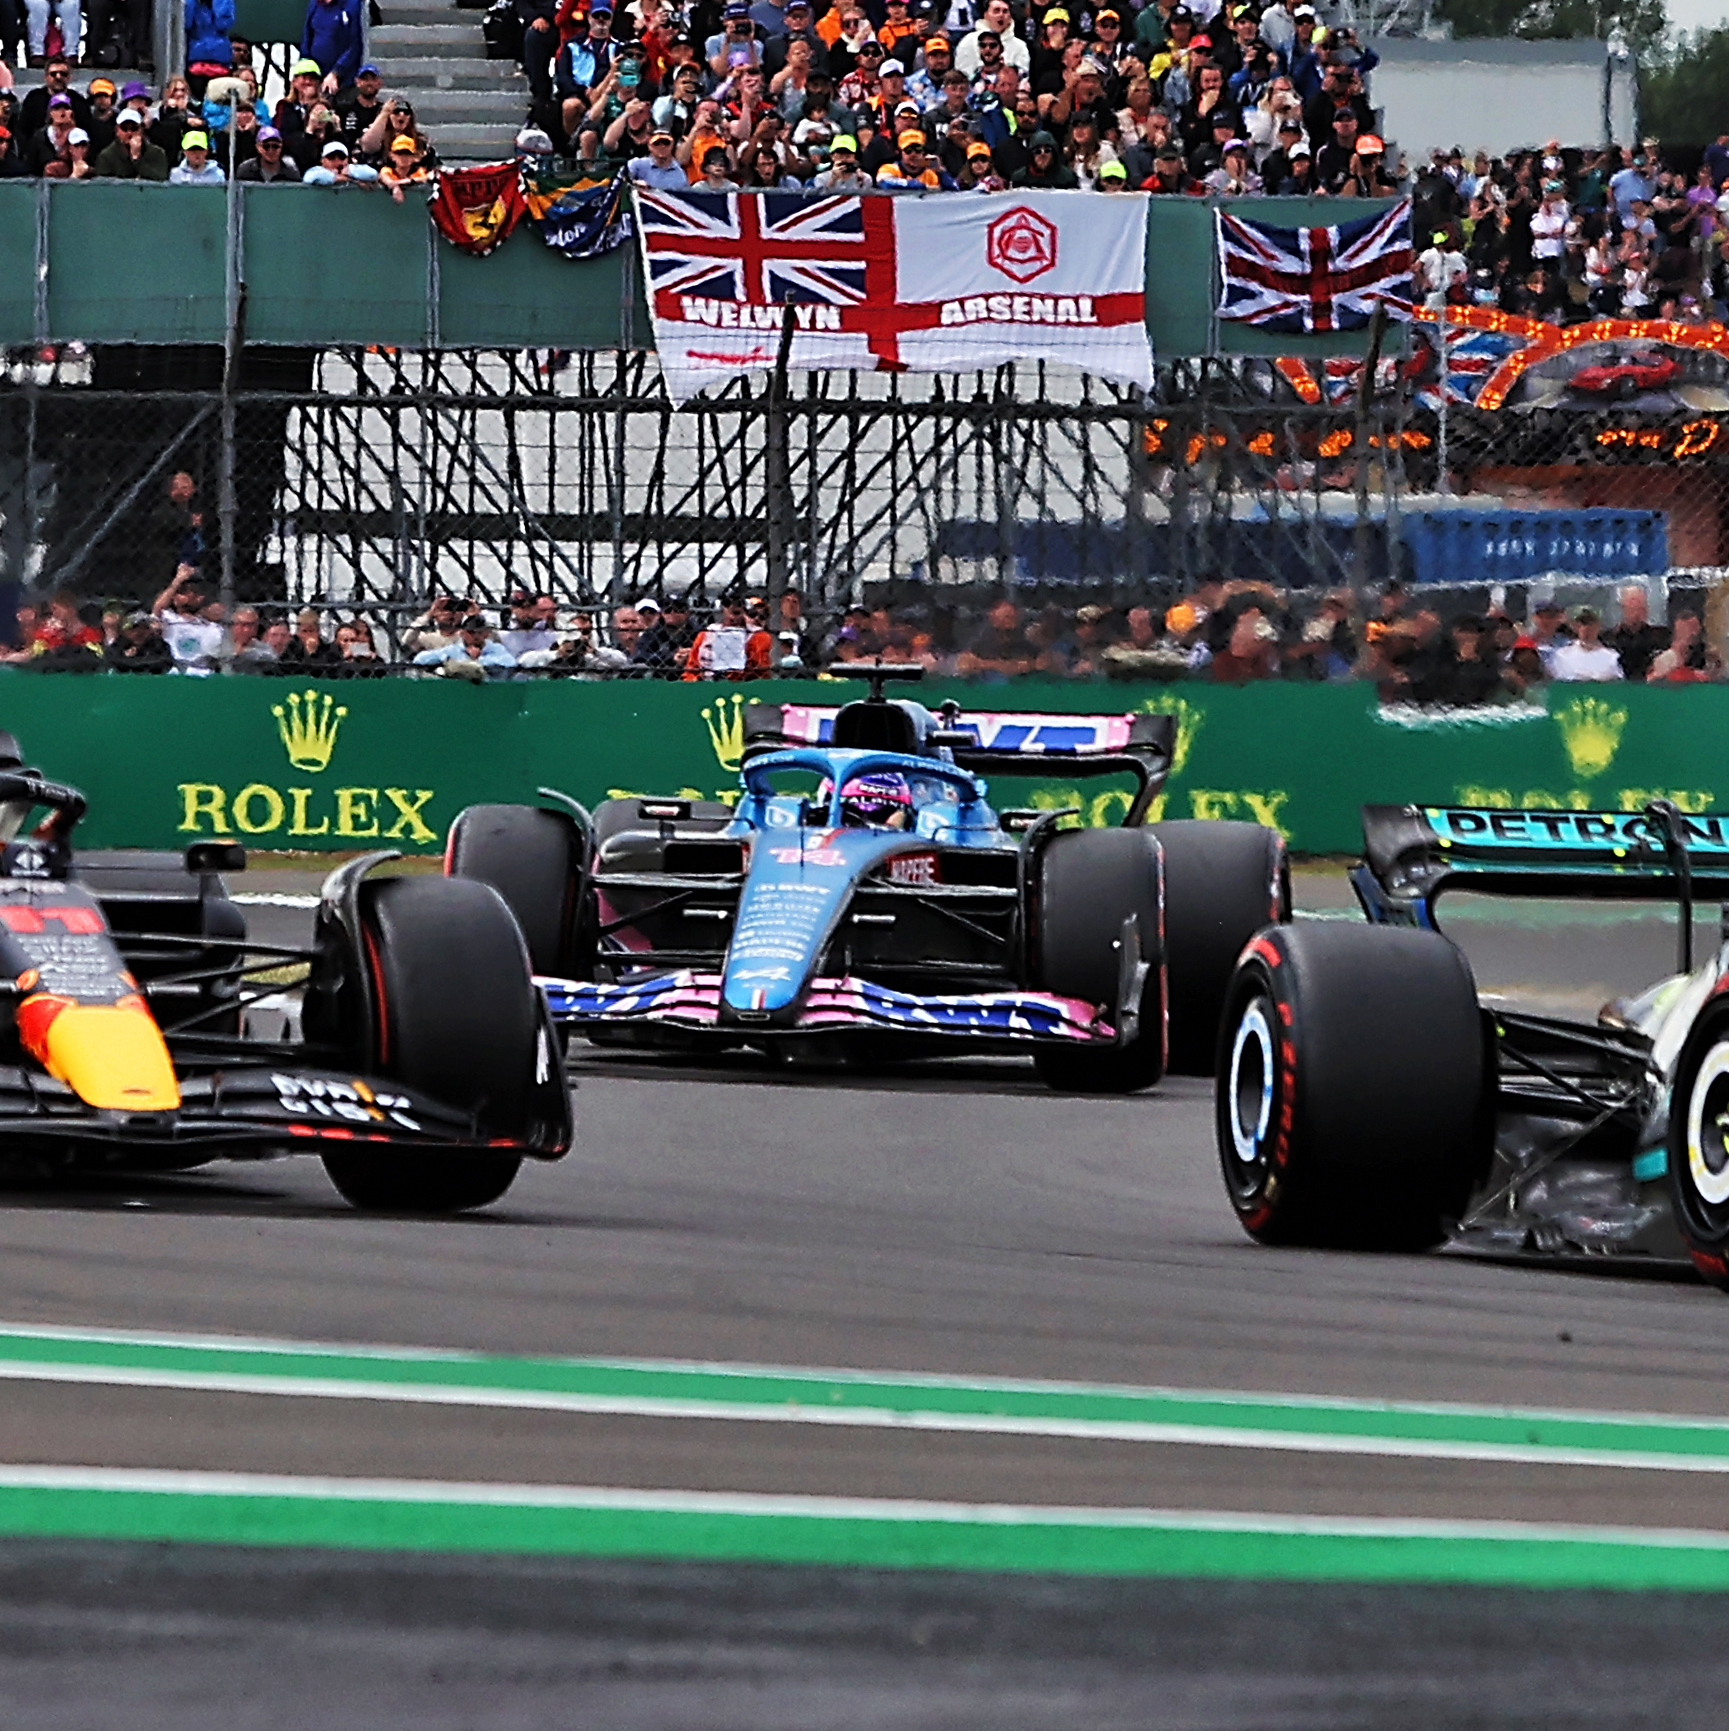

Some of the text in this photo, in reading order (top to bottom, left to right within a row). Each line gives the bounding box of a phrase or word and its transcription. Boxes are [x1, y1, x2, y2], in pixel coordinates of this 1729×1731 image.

[681, 296, 841, 330] WELWYN
[940, 296, 1099, 326] ARSENAL
[177, 782, 439, 844] ROLEX
